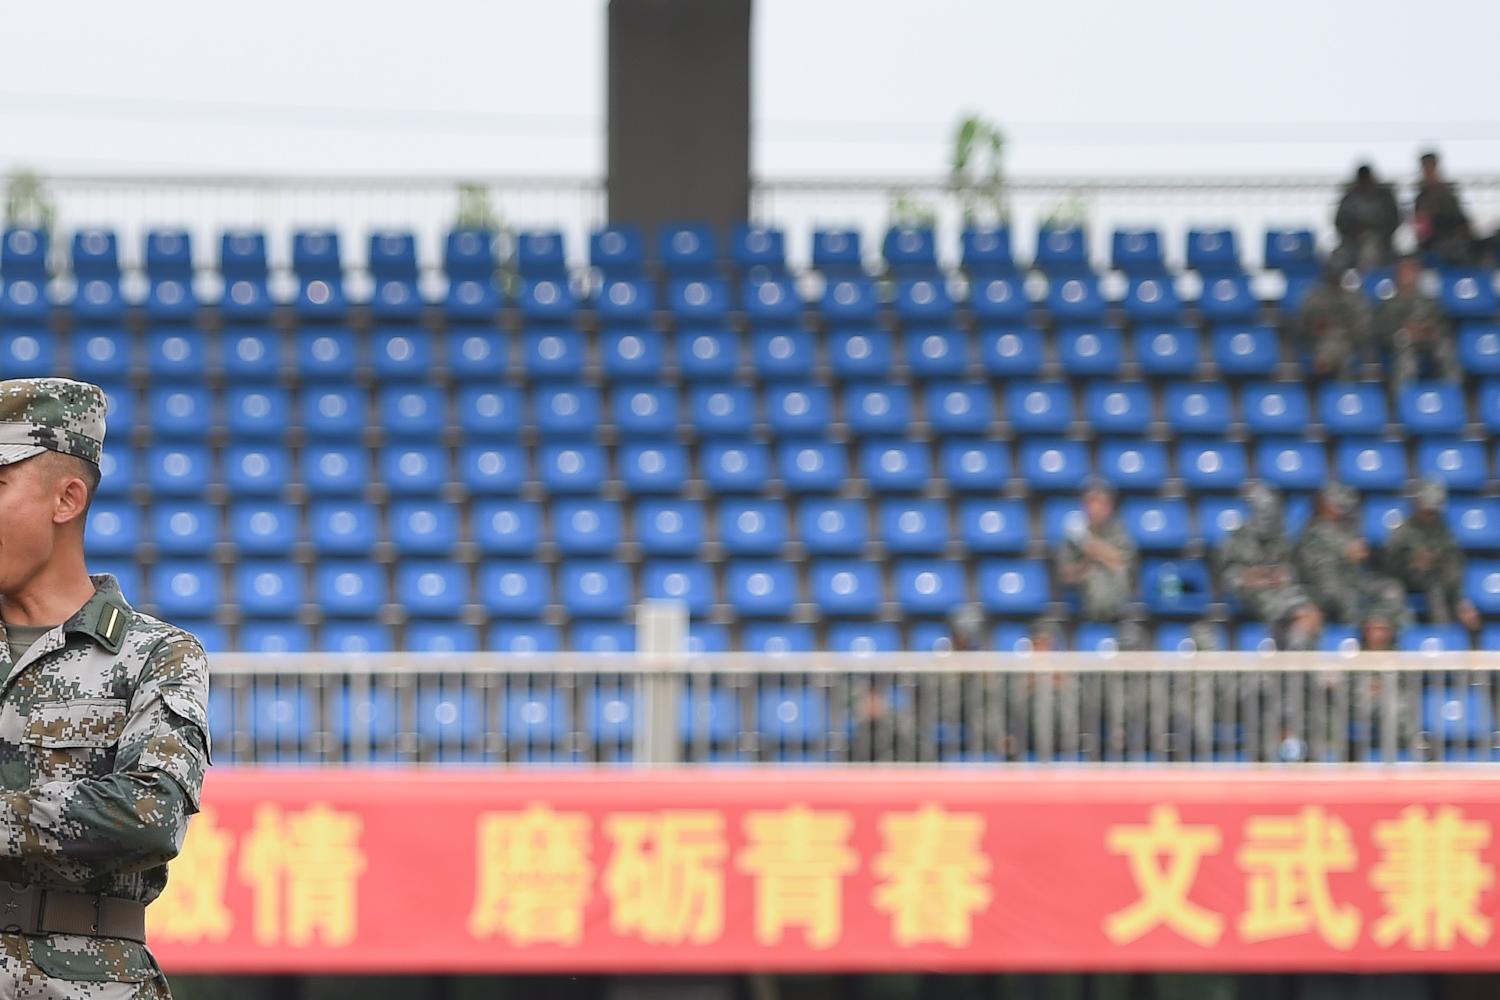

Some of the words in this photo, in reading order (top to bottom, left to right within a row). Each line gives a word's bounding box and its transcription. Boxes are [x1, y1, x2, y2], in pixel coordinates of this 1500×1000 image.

[471, 804, 993, 946] 磨砺青春
[1104, 805, 1494, 949] 文武兼
